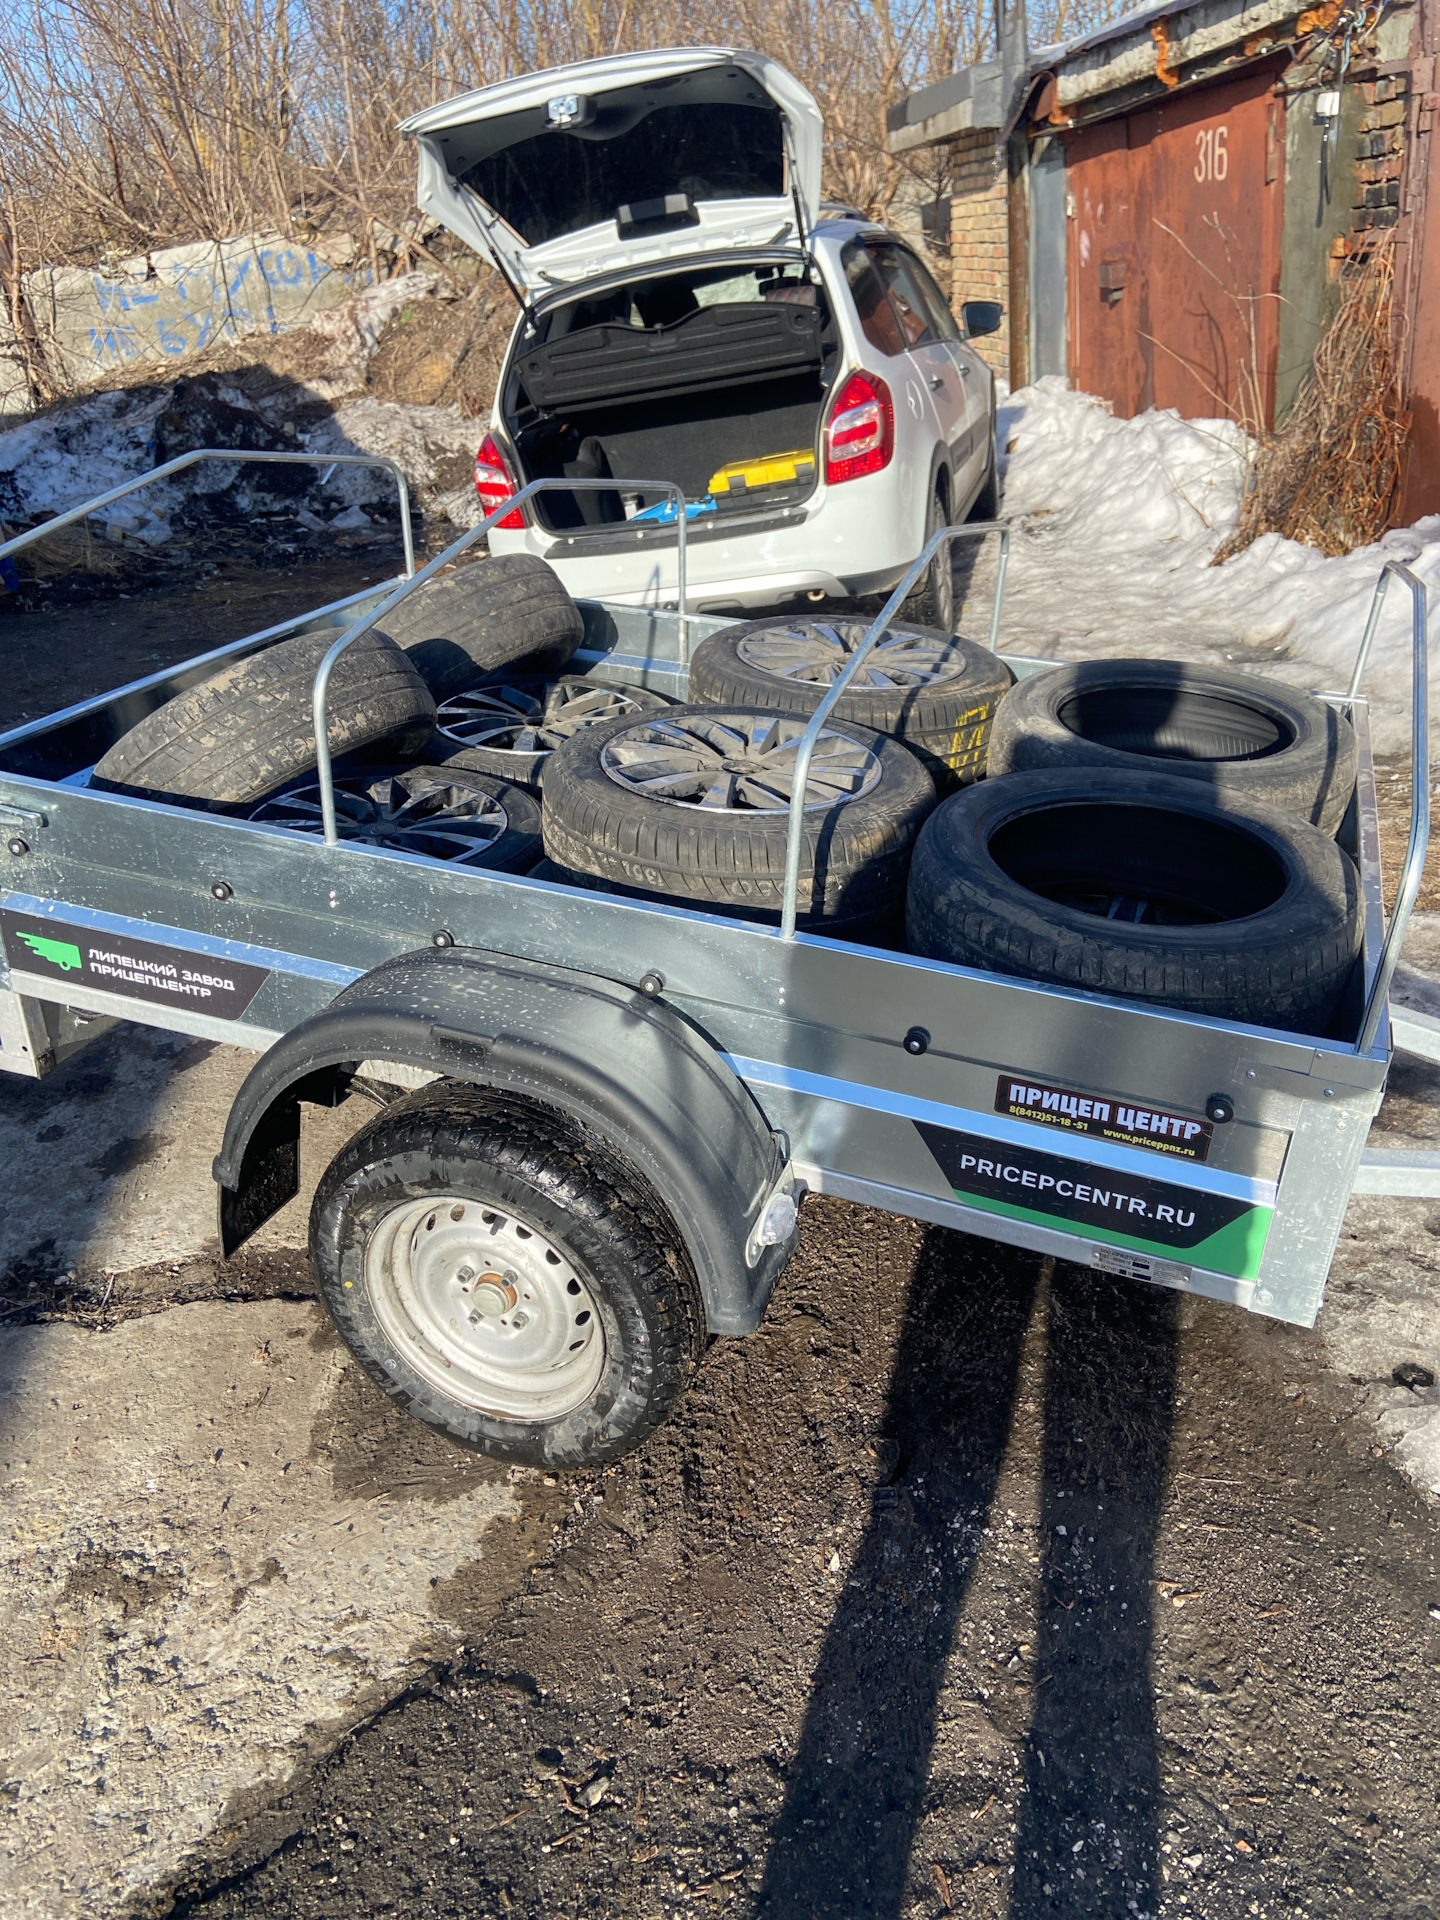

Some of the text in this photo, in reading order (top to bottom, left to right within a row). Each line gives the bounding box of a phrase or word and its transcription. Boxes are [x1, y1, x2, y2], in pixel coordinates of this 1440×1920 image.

[1194, 126, 1228, 183] 316
[88, 948, 236, 991] ЛИПЕЦКИЙ ЗАВОД
[89, 962, 212, 998] ПРИЦЕПЦЕНТР
[1009, 1083, 1202, 1140] ПРИЦЕП ЦЕНТР
[1103, 1127, 1196, 1157] www.priceppnz.ru
[960, 1154, 1196, 1228] PRICEPCENTR.RU
